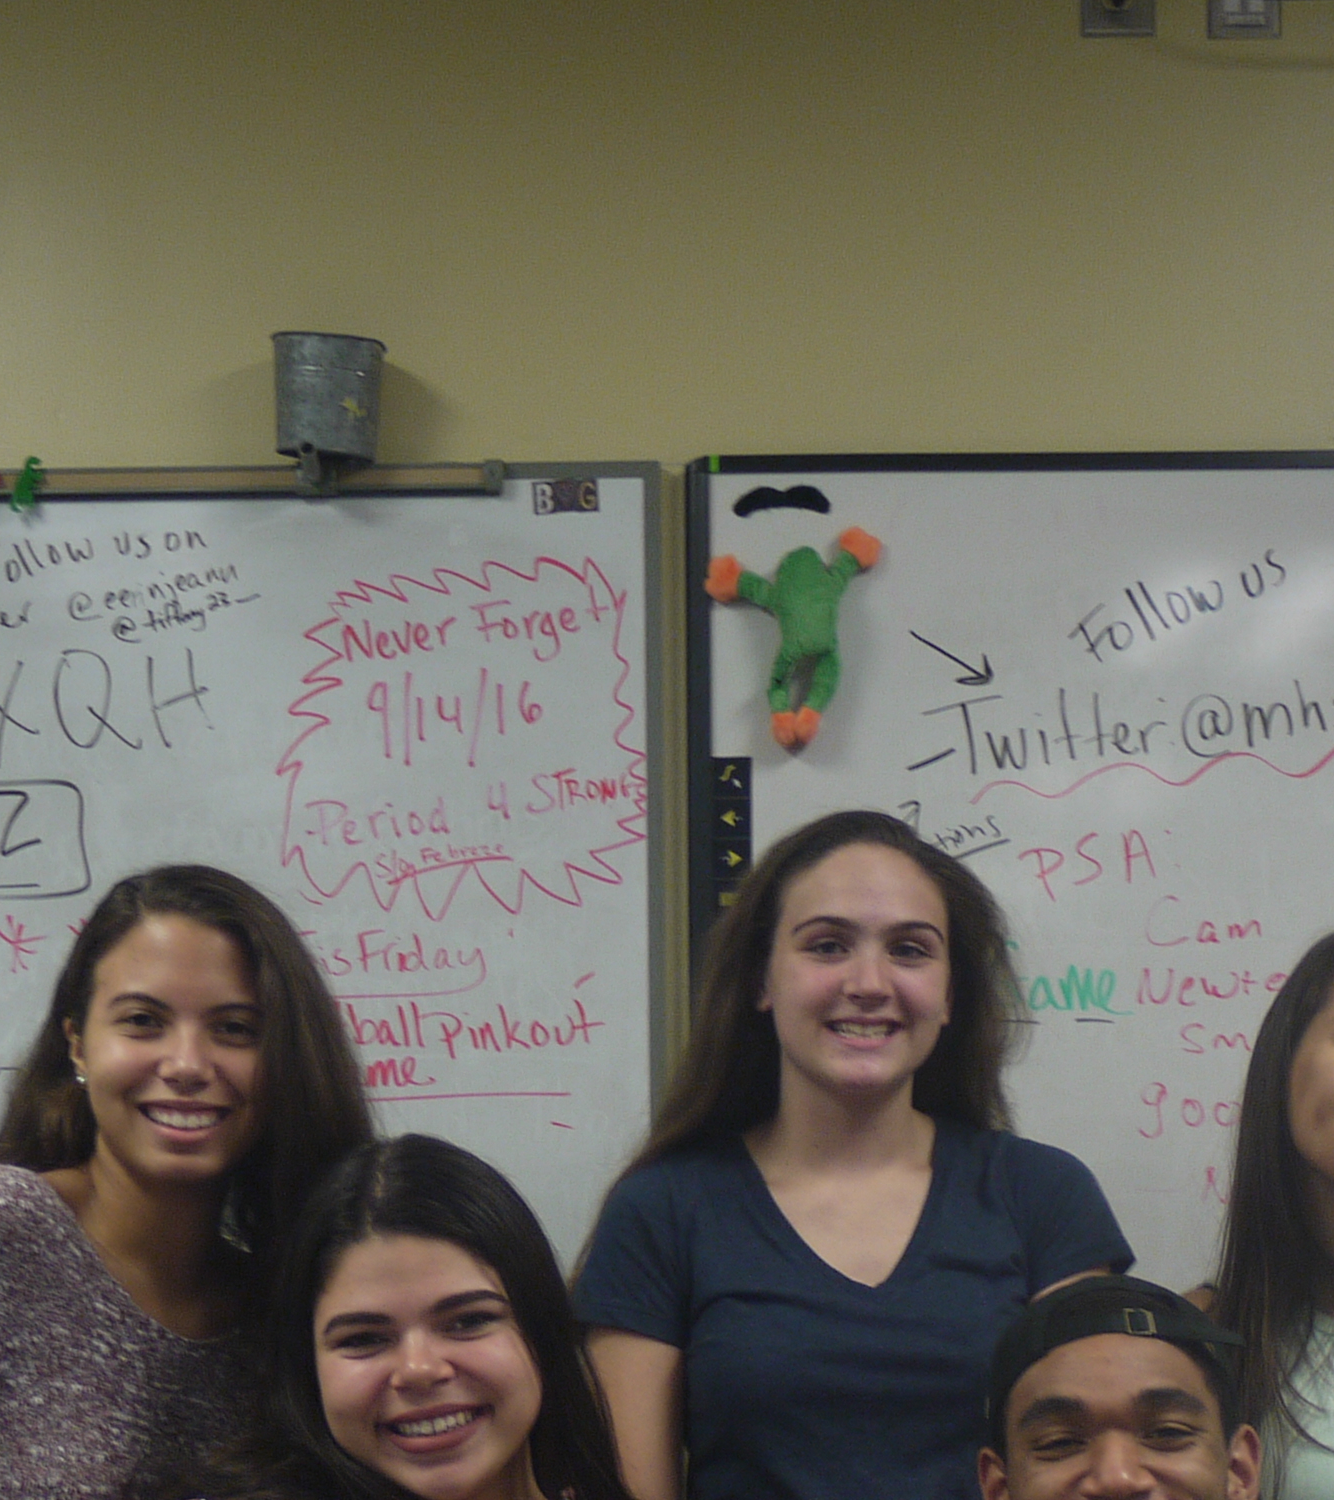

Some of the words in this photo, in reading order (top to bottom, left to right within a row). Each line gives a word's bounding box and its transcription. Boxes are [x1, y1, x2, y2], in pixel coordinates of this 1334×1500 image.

[534, 482, 599, 514] BG
[164, 529, 209, 553] on
[340, 616, 457, 663] Never
[470, 584, 624, 661] Forget
[1068, 579, 1225, 663] Follow
[1240, 548, 1288, 599] us
[366, 666, 546, 768] 9/14/16
[487, 782, 514, 821] 4
[1146, 894, 1263, 947] Cam
